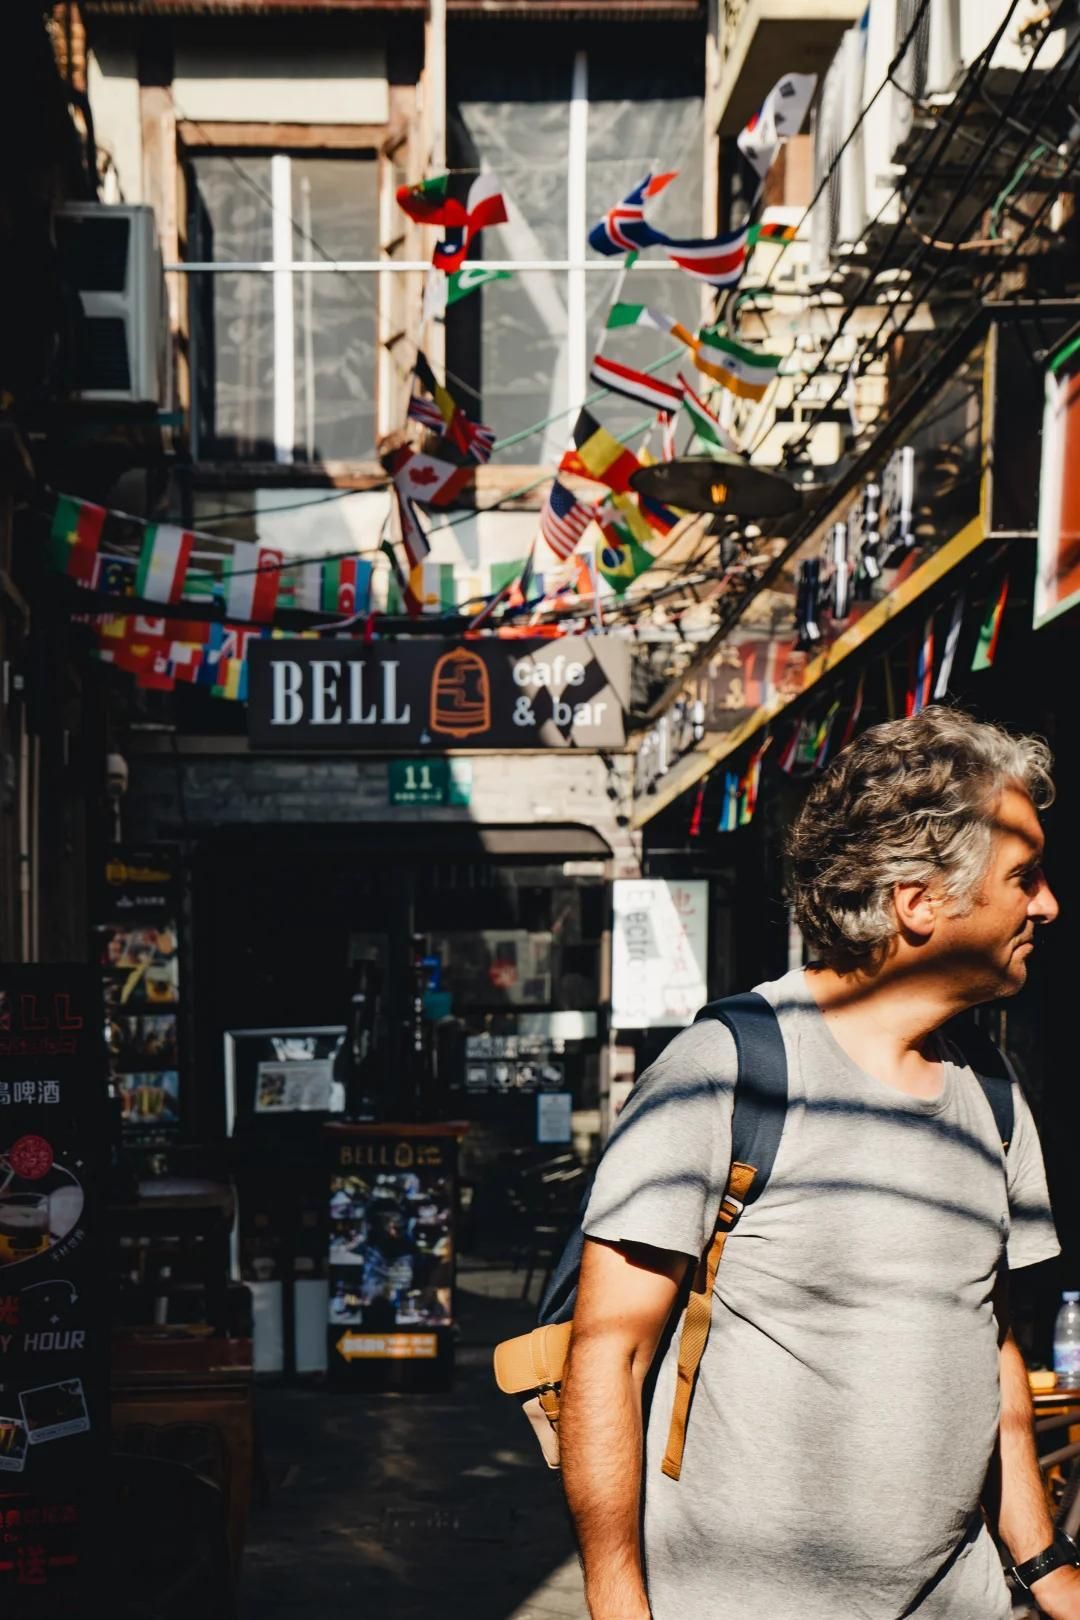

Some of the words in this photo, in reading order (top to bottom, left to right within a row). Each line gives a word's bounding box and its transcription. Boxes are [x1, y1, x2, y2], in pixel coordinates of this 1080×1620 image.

[512, 656, 586, 687] cafe
[270, 660, 411, 725] BELL
[512, 698, 536, 727] &
[552, 698, 607, 727] bar
[403, 765, 433, 790] 11
[340, 1145, 389, 1166] BELL
[23, 1329, 86, 1353] HOUR
